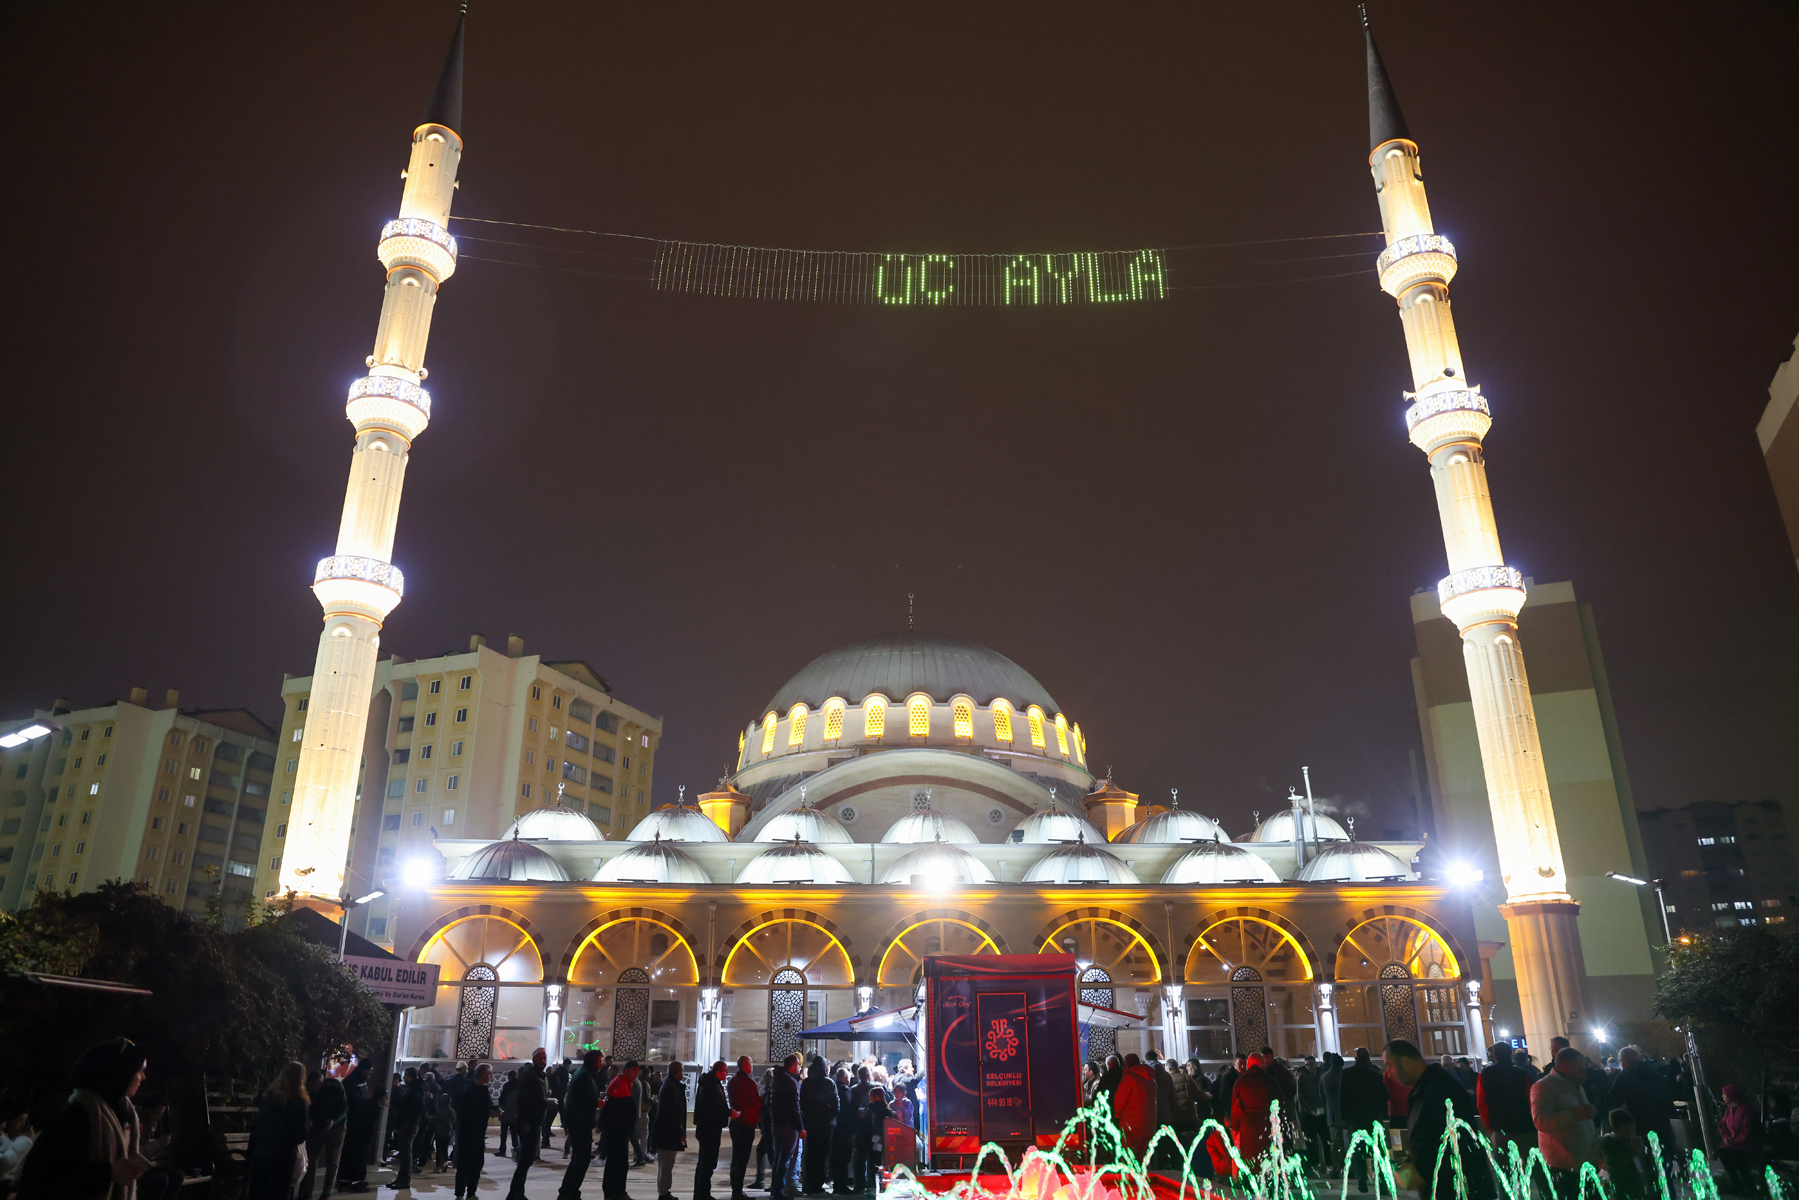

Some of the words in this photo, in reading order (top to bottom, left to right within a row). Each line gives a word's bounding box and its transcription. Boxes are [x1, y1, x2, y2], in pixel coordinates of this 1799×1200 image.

[877, 253, 953, 306] ÜÇ
[1005, 249, 1163, 305] AYLA
[360, 965, 393, 982] KABUL
[396, 966, 427, 985] EDİLİR
[986, 1072, 1022, 1081] SELÇUKLU
[986, 1079, 1023, 1087] BELEDİYESİ
[987, 1098, 998, 1107] 444
